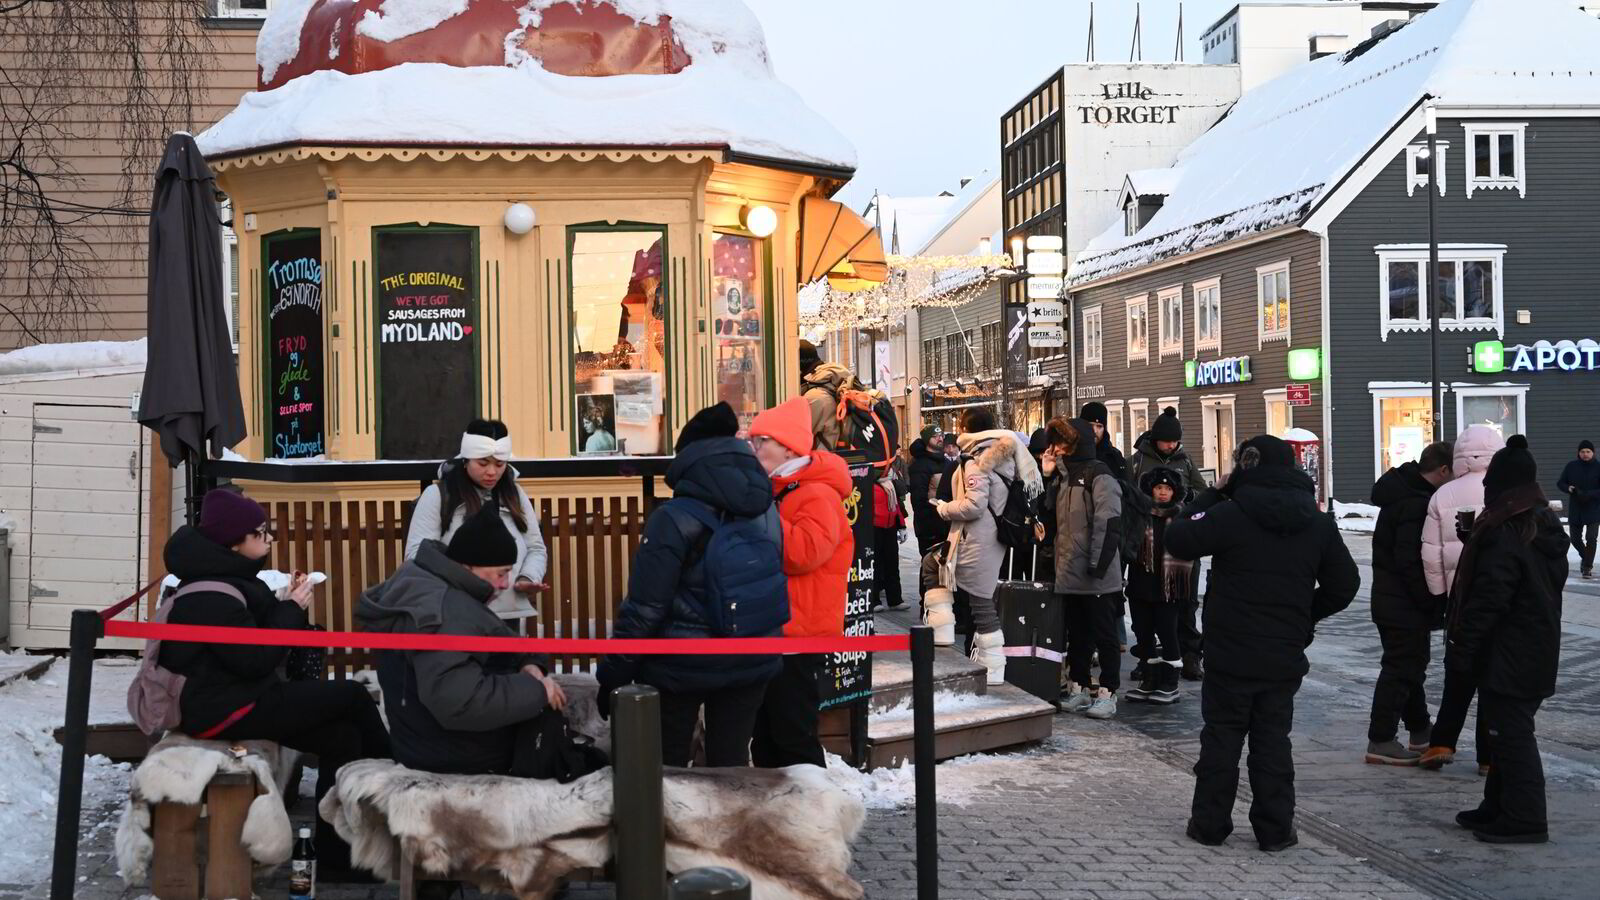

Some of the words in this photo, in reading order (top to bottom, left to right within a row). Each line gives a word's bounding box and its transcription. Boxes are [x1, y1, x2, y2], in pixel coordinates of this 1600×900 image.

[1100, 81, 1153, 101] Lille
[1077, 105, 1180, 125] TORGET
[381, 273, 408, 291] THE
[409, 272, 465, 291] ORIGINAL
[430, 294, 450, 306] GOT
[388, 309, 440, 320] SAUSAGES
[440, 308, 466, 319] FROM
[1043, 307, 1062, 317] britts
[382, 321, 463, 343] MYDLAND
[279, 335, 307, 356] FRYD
[1196, 360, 1239, 386] APOTEK
[280, 404, 298, 416] SELFIE
[298, 402, 313, 414] SPOT
[858, 558, 875, 581] beef
[844, 588, 871, 616] beef
